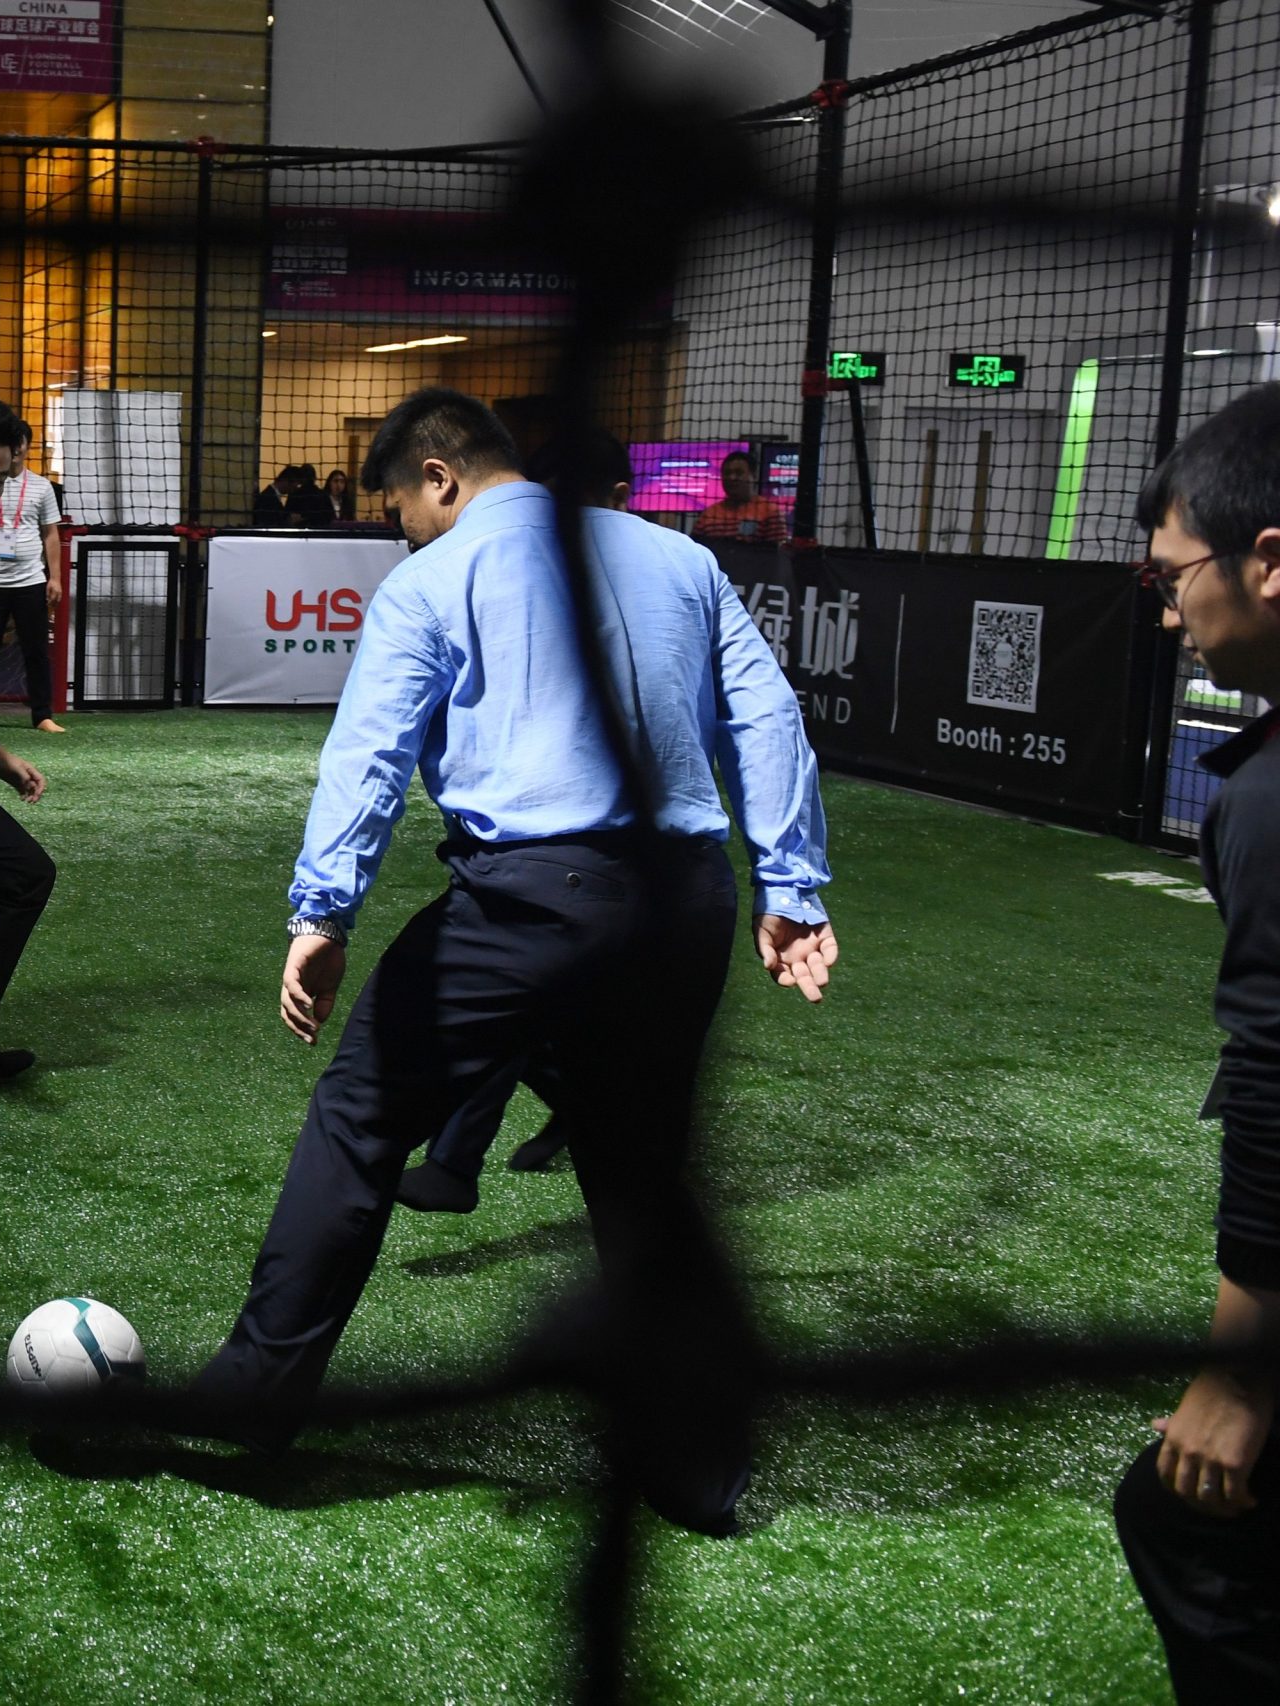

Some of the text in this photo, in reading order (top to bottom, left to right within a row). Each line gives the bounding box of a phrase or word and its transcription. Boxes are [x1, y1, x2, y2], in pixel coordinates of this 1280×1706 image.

[19, 1, 68, 14] CHINA
[413, 269, 577, 290] INFORMATION
[265, 587, 363, 632] UHS
[264, 638, 356, 654] SPORT
[936, 717, 1002, 754] Booth
[1022, 732, 1067, 766] 255
